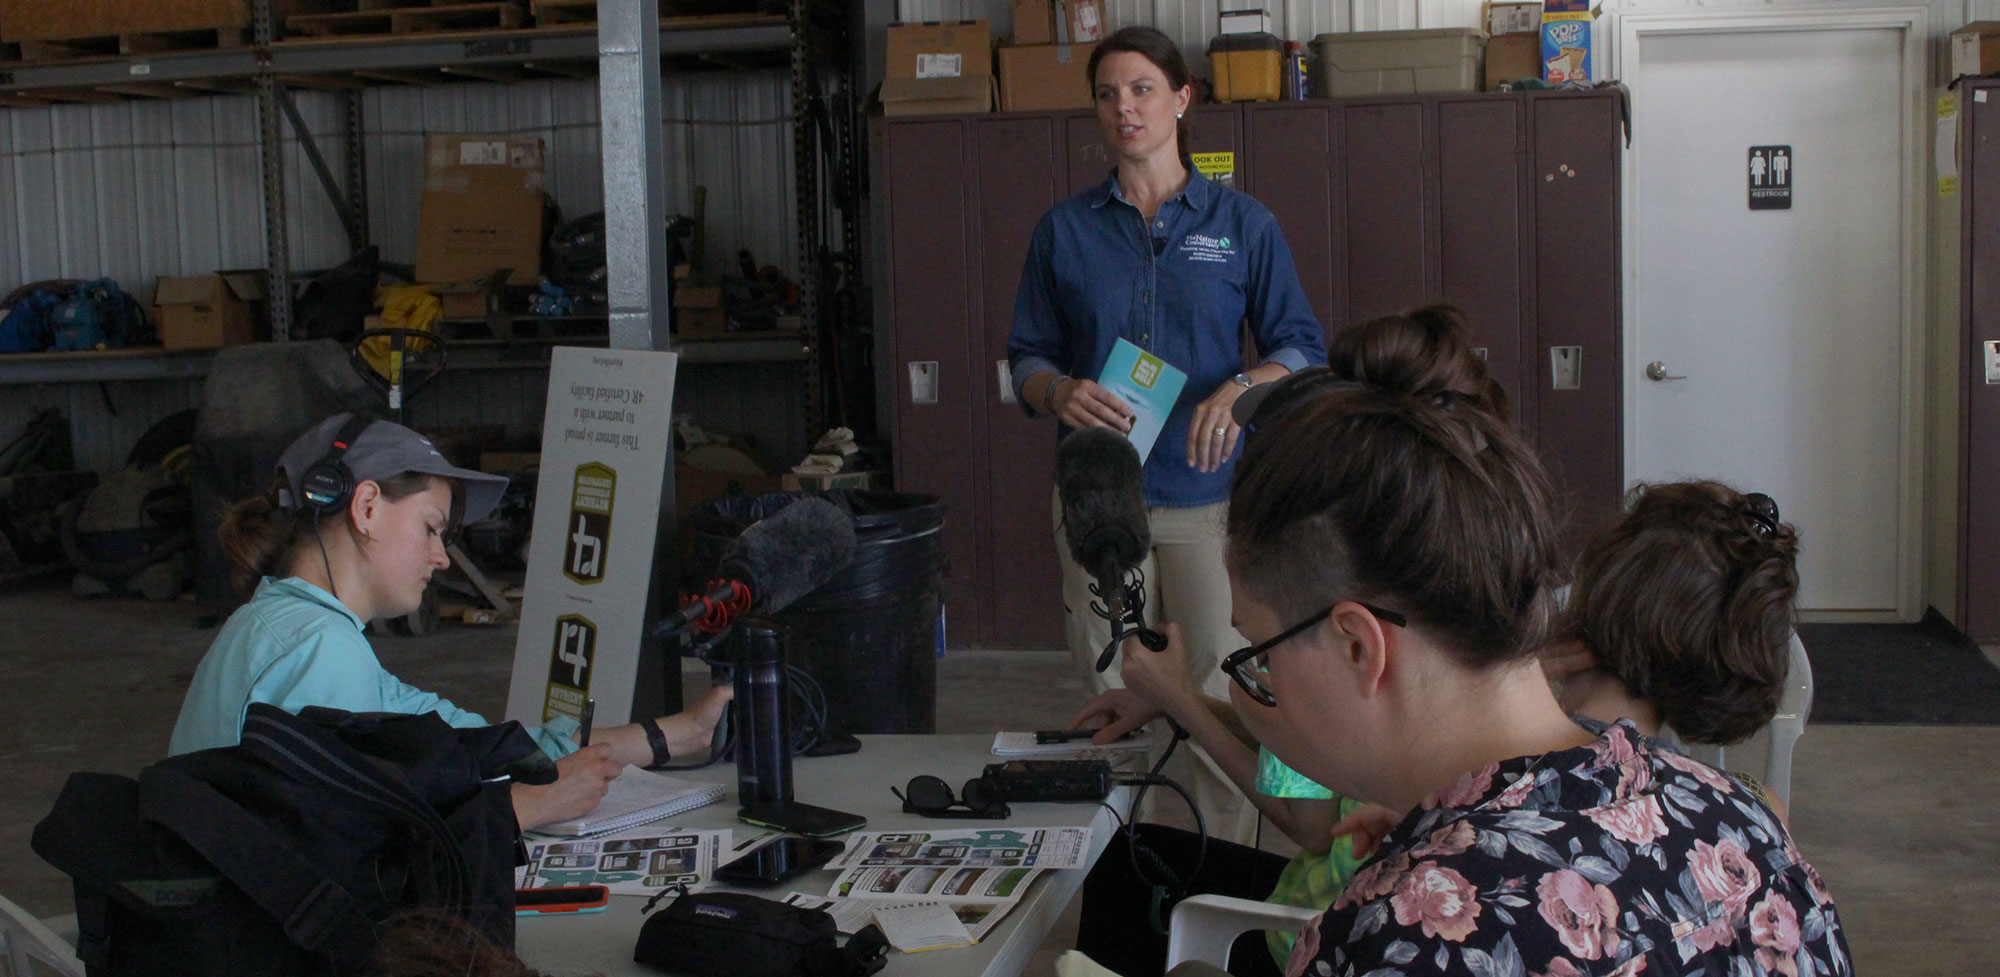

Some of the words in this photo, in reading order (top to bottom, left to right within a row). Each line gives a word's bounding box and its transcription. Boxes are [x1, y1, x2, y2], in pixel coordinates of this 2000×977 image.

[1195, 234, 1219, 245] Nature
[596, 387, 630, 404] Certified
[632, 390, 645, 405] 4R
[574, 408, 579, 418] a
[580, 408, 596, 422] with
[597, 408, 625, 422] partner
[626, 412, 635, 424] to
[441, 437, 459, 445] SONY
[565, 427, 586, 442] proud
[587, 431, 594, 446] is
[595, 432, 620, 448] farmer
[621, 434, 640, 450] This
